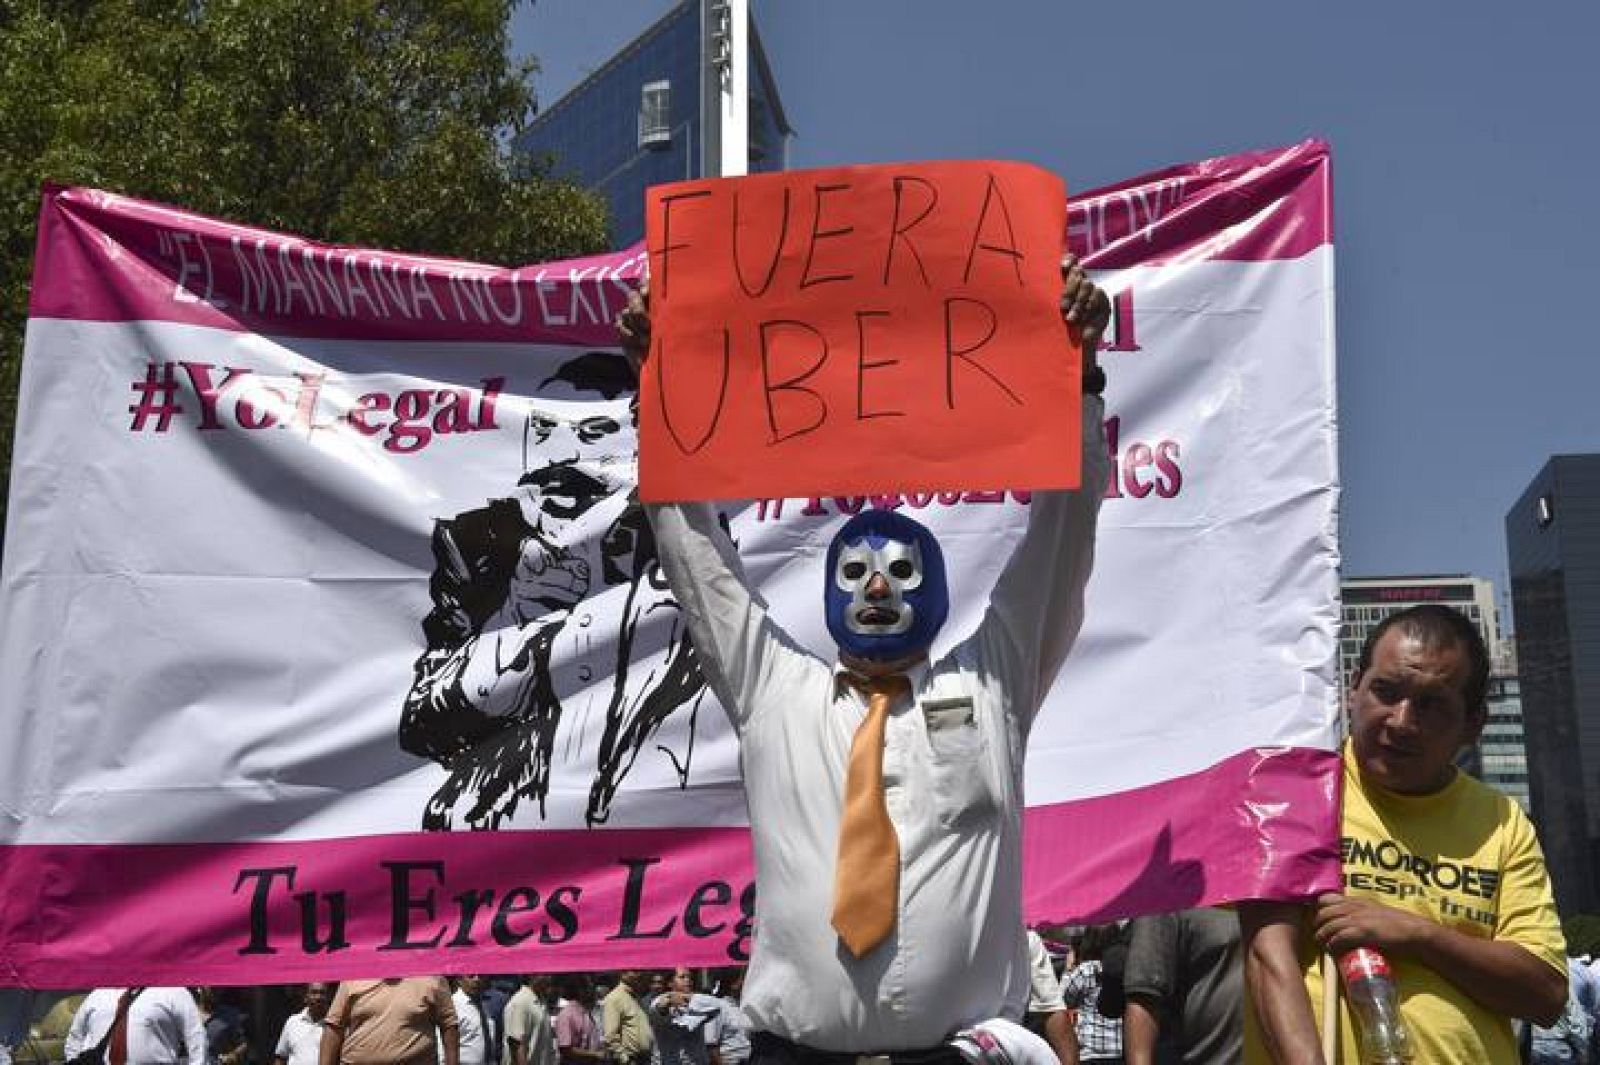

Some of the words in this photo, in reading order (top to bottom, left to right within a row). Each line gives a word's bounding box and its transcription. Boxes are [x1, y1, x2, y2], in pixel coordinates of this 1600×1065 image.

[655, 173, 1024, 299] FUERA
[128, 360, 506, 453] #YoLegal
[658, 298, 1023, 456] UBER
[233, 865, 351, 955] Tu
[376, 859, 582, 951] Eres
